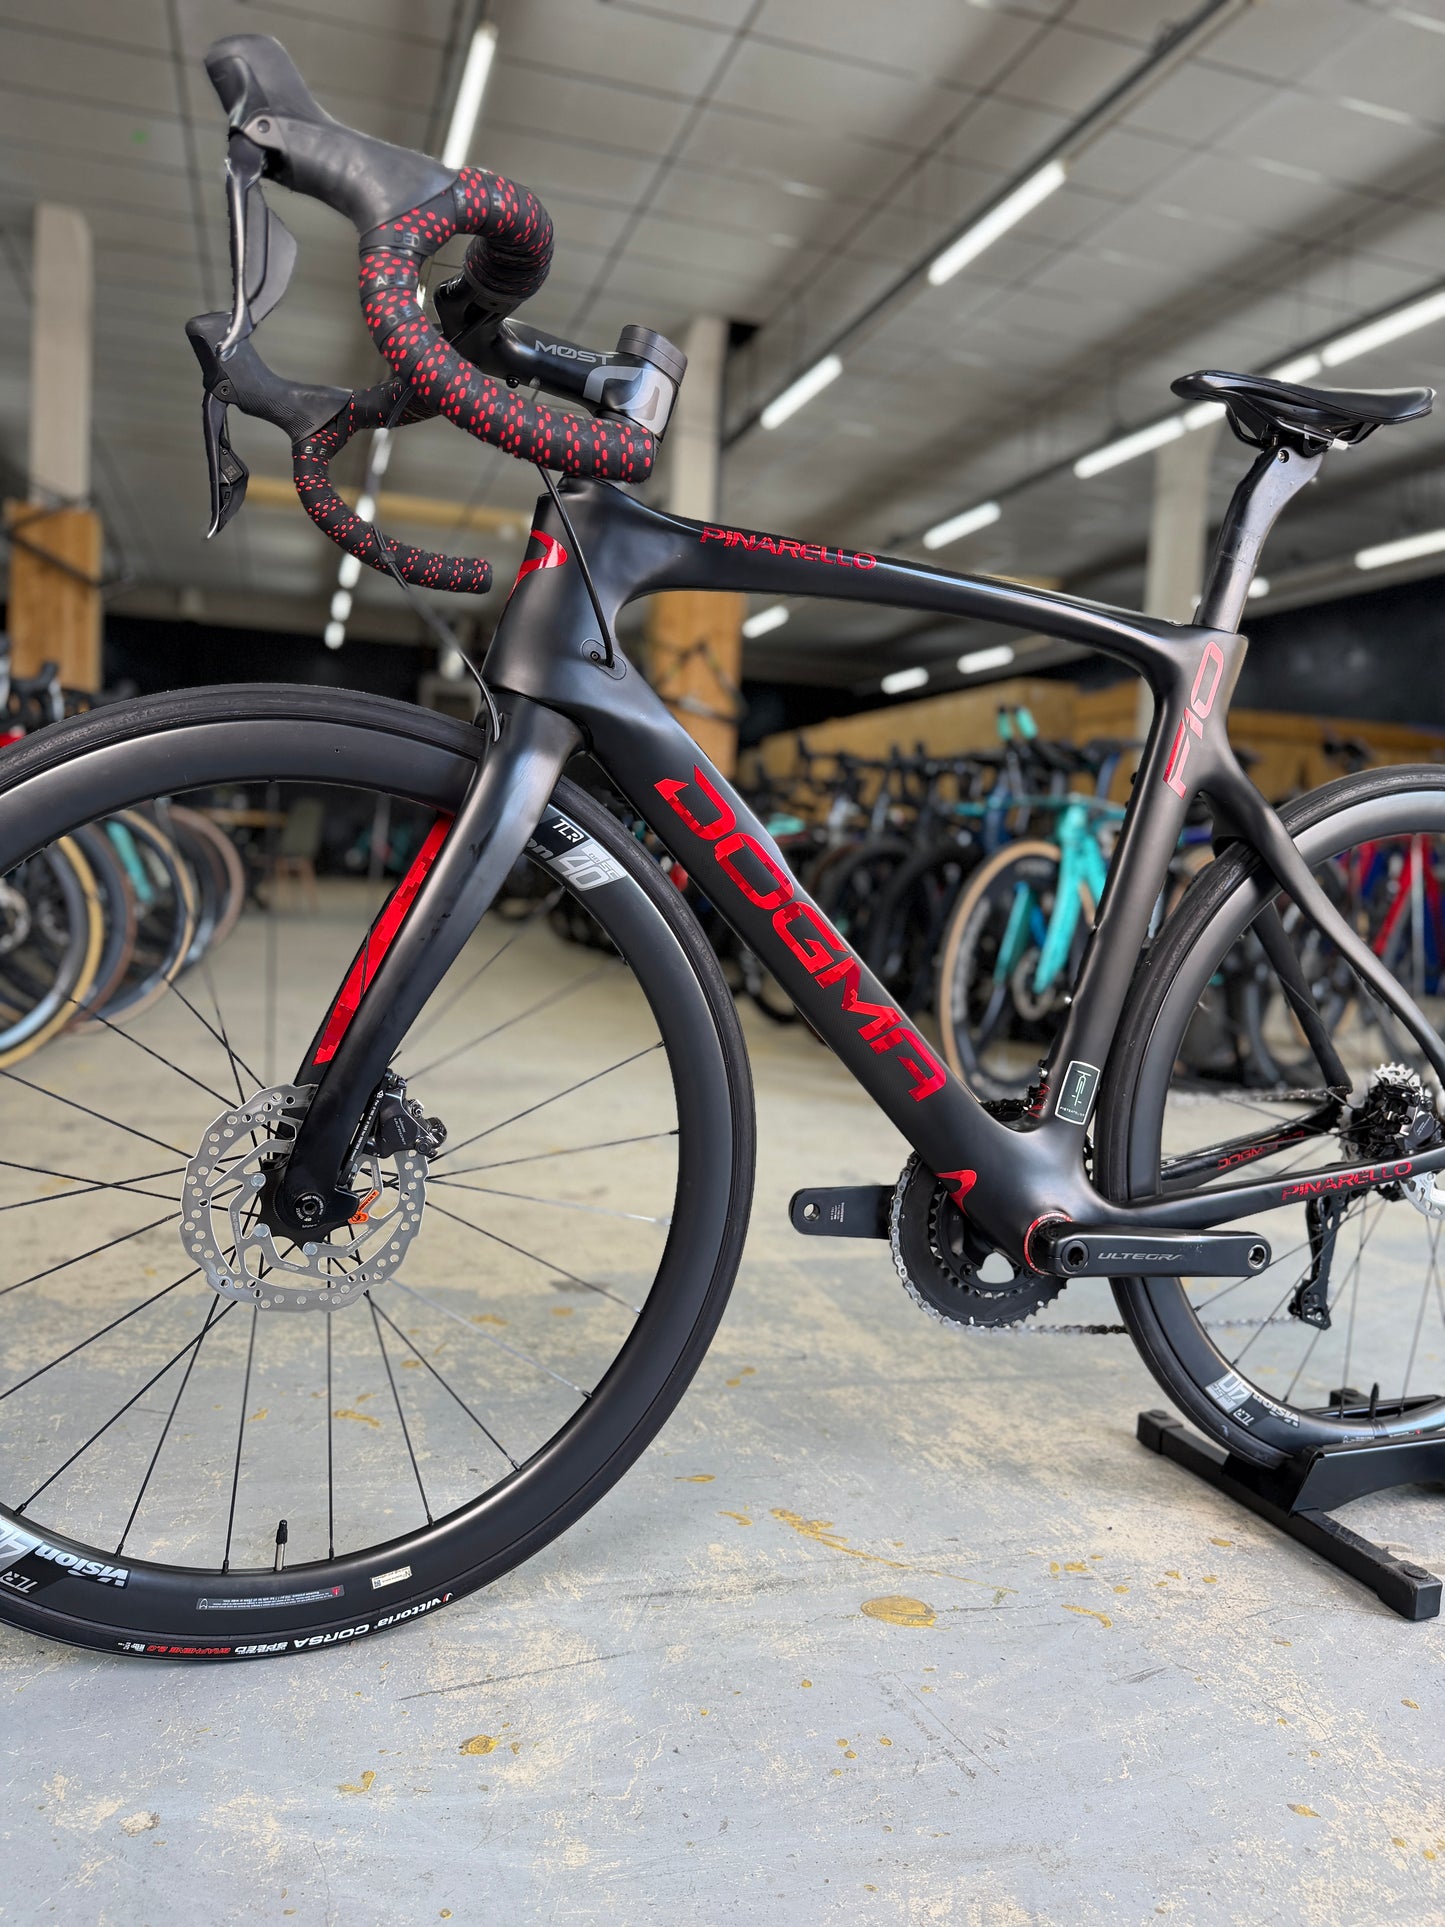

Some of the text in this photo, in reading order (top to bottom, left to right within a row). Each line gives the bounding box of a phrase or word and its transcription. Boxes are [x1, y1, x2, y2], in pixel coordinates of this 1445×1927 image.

[700, 526, 877, 570] PINARELLO
[1163, 641, 1224, 799] F10
[552, 818, 584, 843] TLR
[558, 855, 610, 892] 40
[654, 764, 947, 1102] DOGMA
[1282, 1161, 1413, 1201] PINARELLO
[1233, 1408, 1255, 1427] TLR
[0, 1570, 38, 1593] TLR
[377, 1597, 442, 1627] vittoria
[294, 1623, 370, 1649] CORSA
